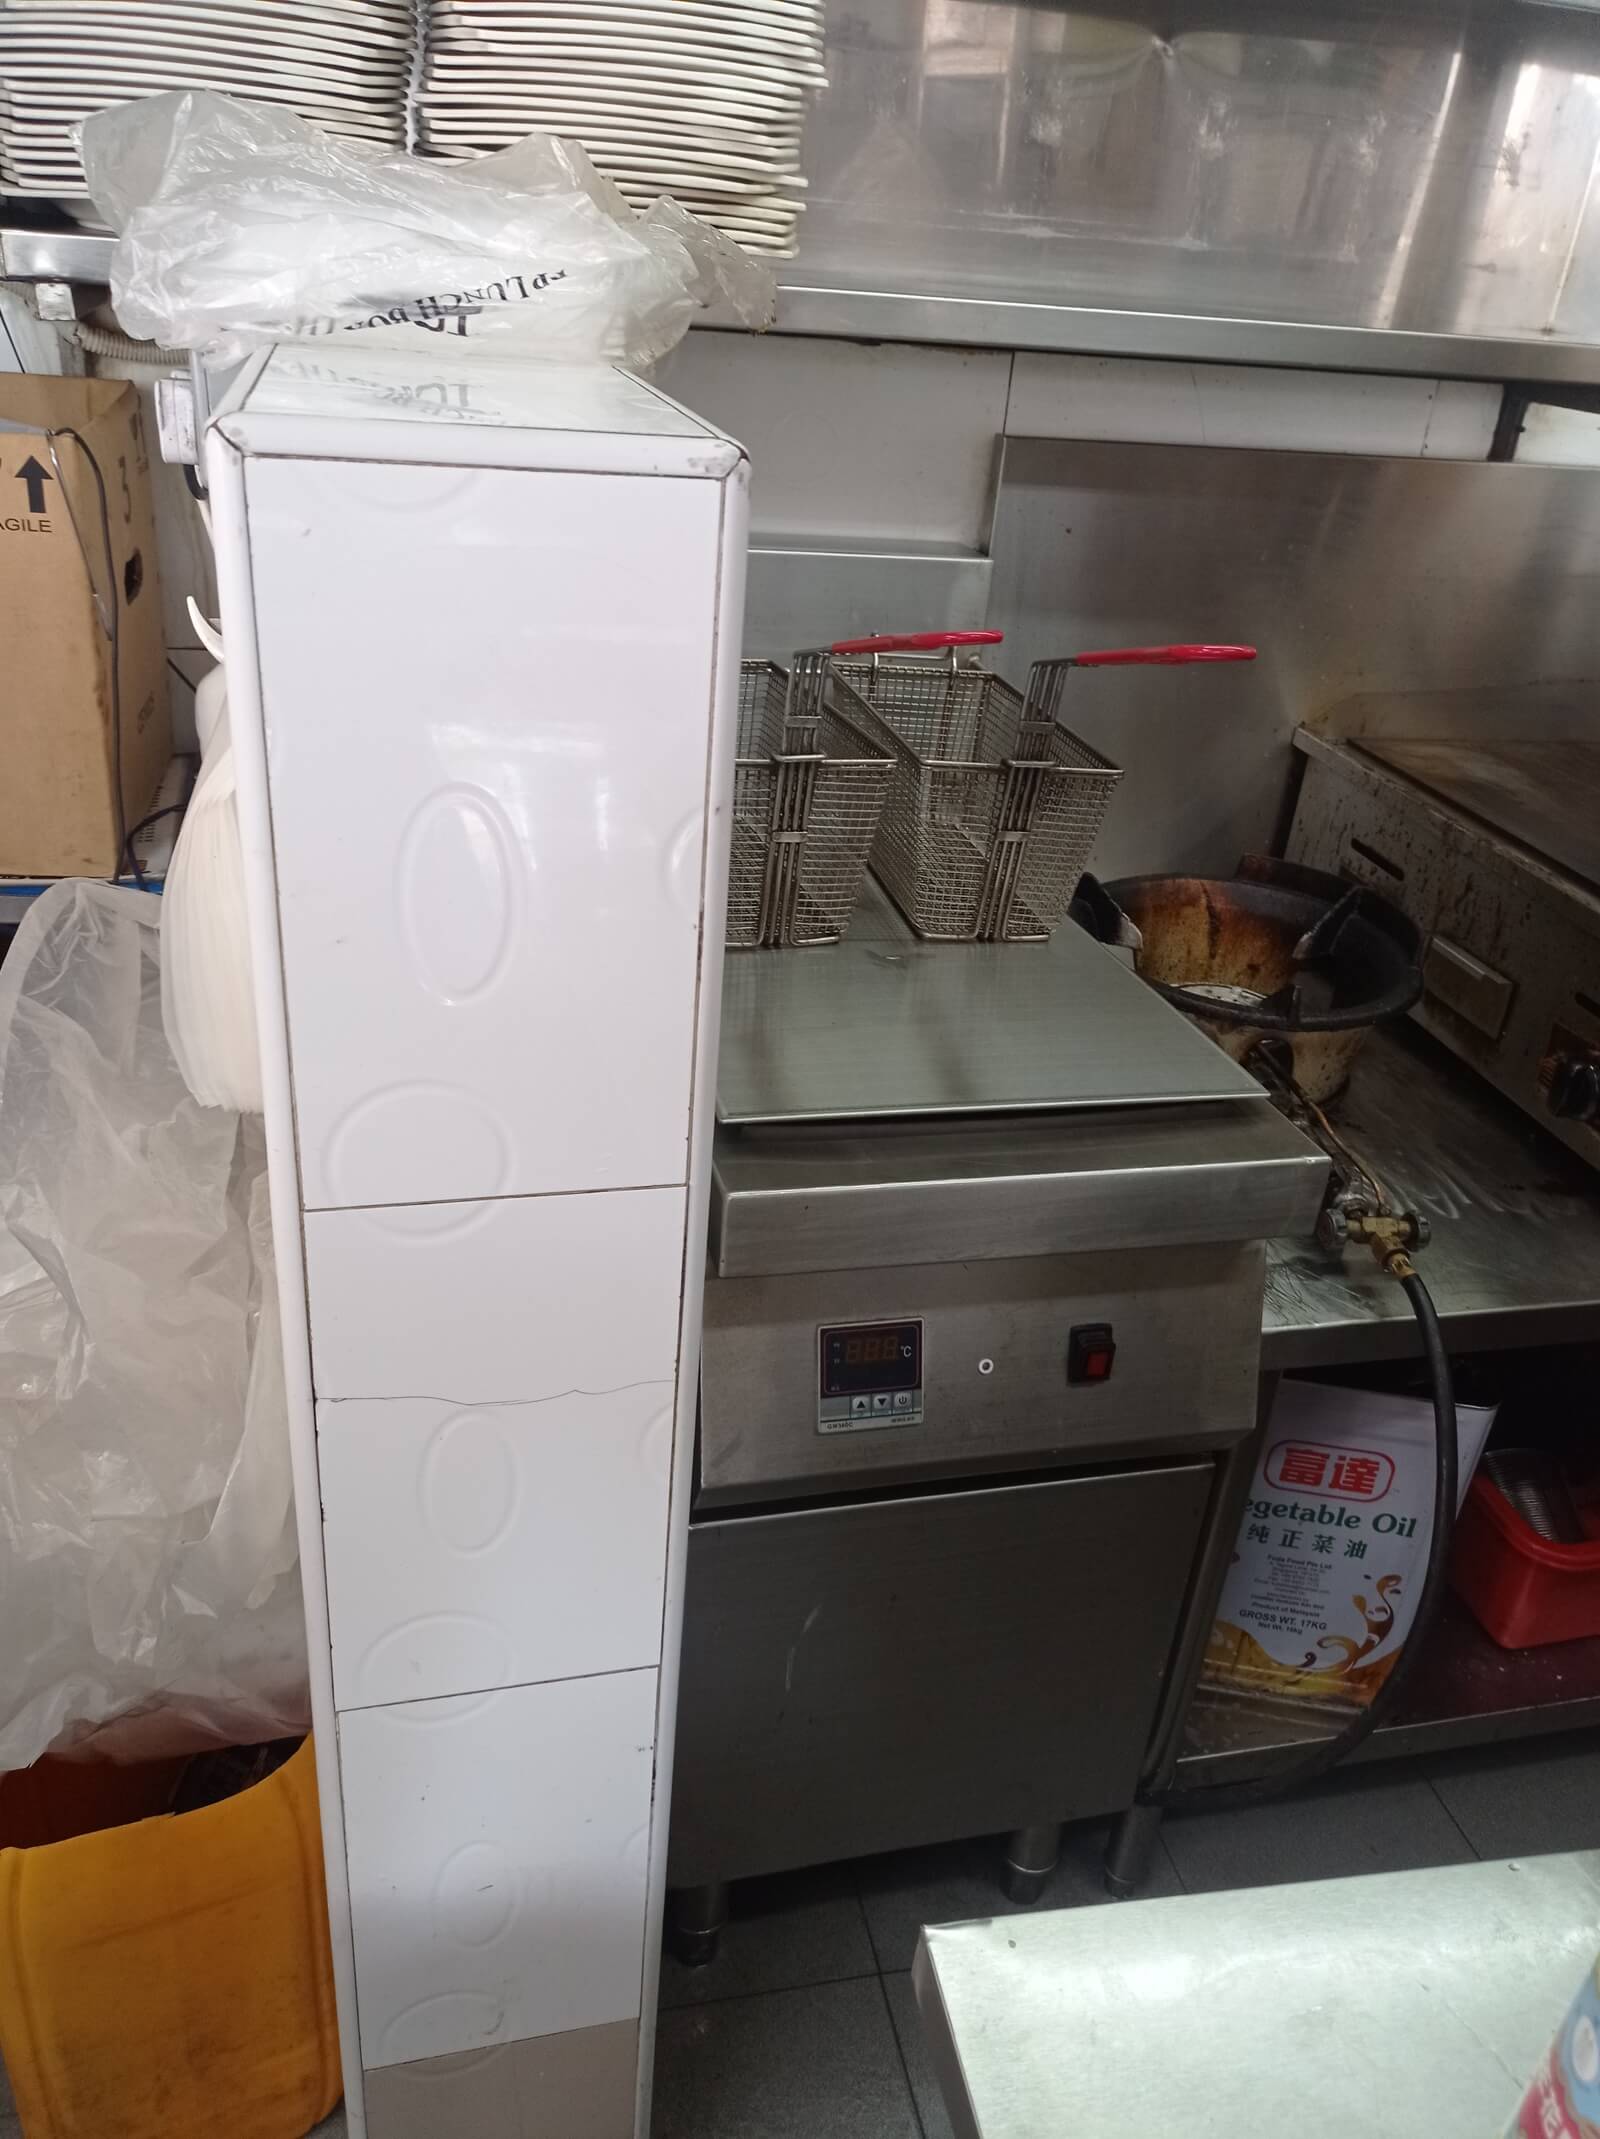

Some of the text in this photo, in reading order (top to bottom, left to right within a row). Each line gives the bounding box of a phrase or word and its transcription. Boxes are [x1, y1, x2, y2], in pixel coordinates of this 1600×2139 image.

[415, 275, 528, 320] LUNCH
[1279, 1448, 1380, 1495] 富達
[1372, 1513, 1417, 1538] Oil
[1246, 1523, 1368, 1560] 纯正菜油
[1239, 1609, 1328, 1630] GROSS WT. 17KG
[1251, 1601, 1279, 1611] Product
